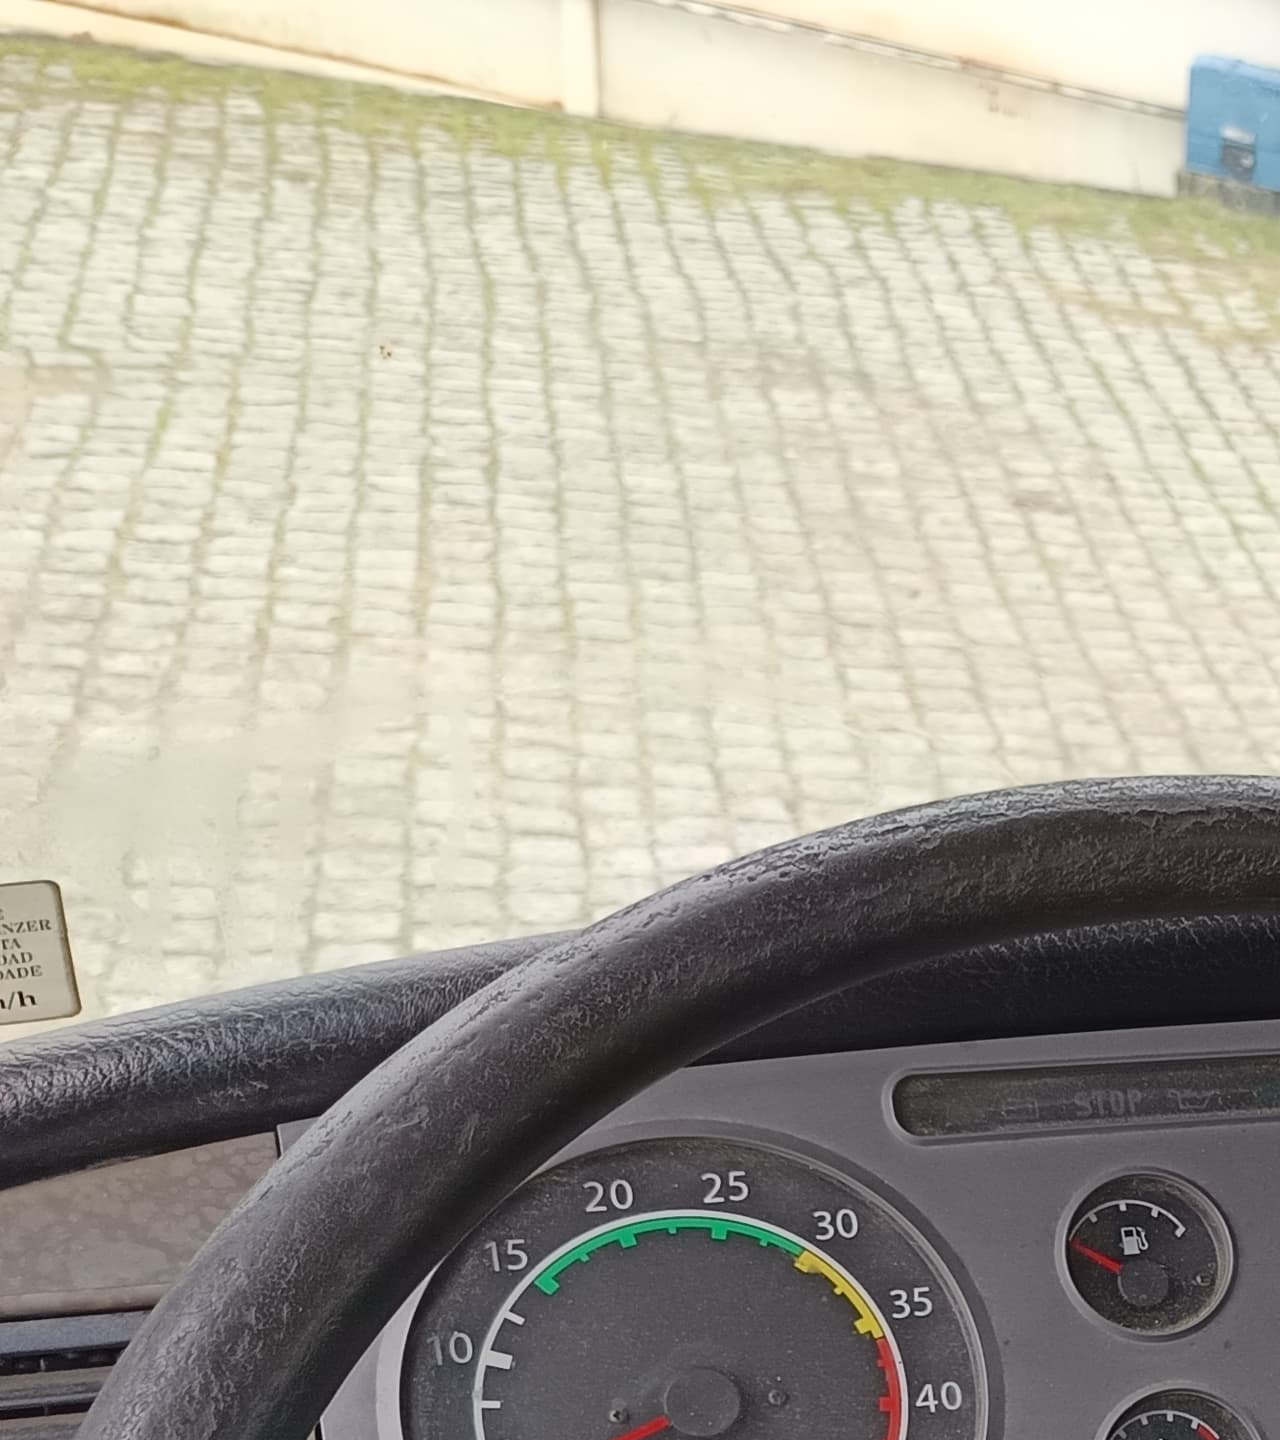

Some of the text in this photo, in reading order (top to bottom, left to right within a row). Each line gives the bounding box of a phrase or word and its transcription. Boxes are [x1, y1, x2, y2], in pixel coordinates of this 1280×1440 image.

[583, 1179, 633, 1213] 20
[701, 1170, 749, 1204] 25
[813, 1208, 858, 1241] 30
[485, 1238, 528, 1272] 15
[889, 1286, 933, 1319] 35
[429, 1331, 473, 1366] 10
[915, 1381, 962, 1413] 40
